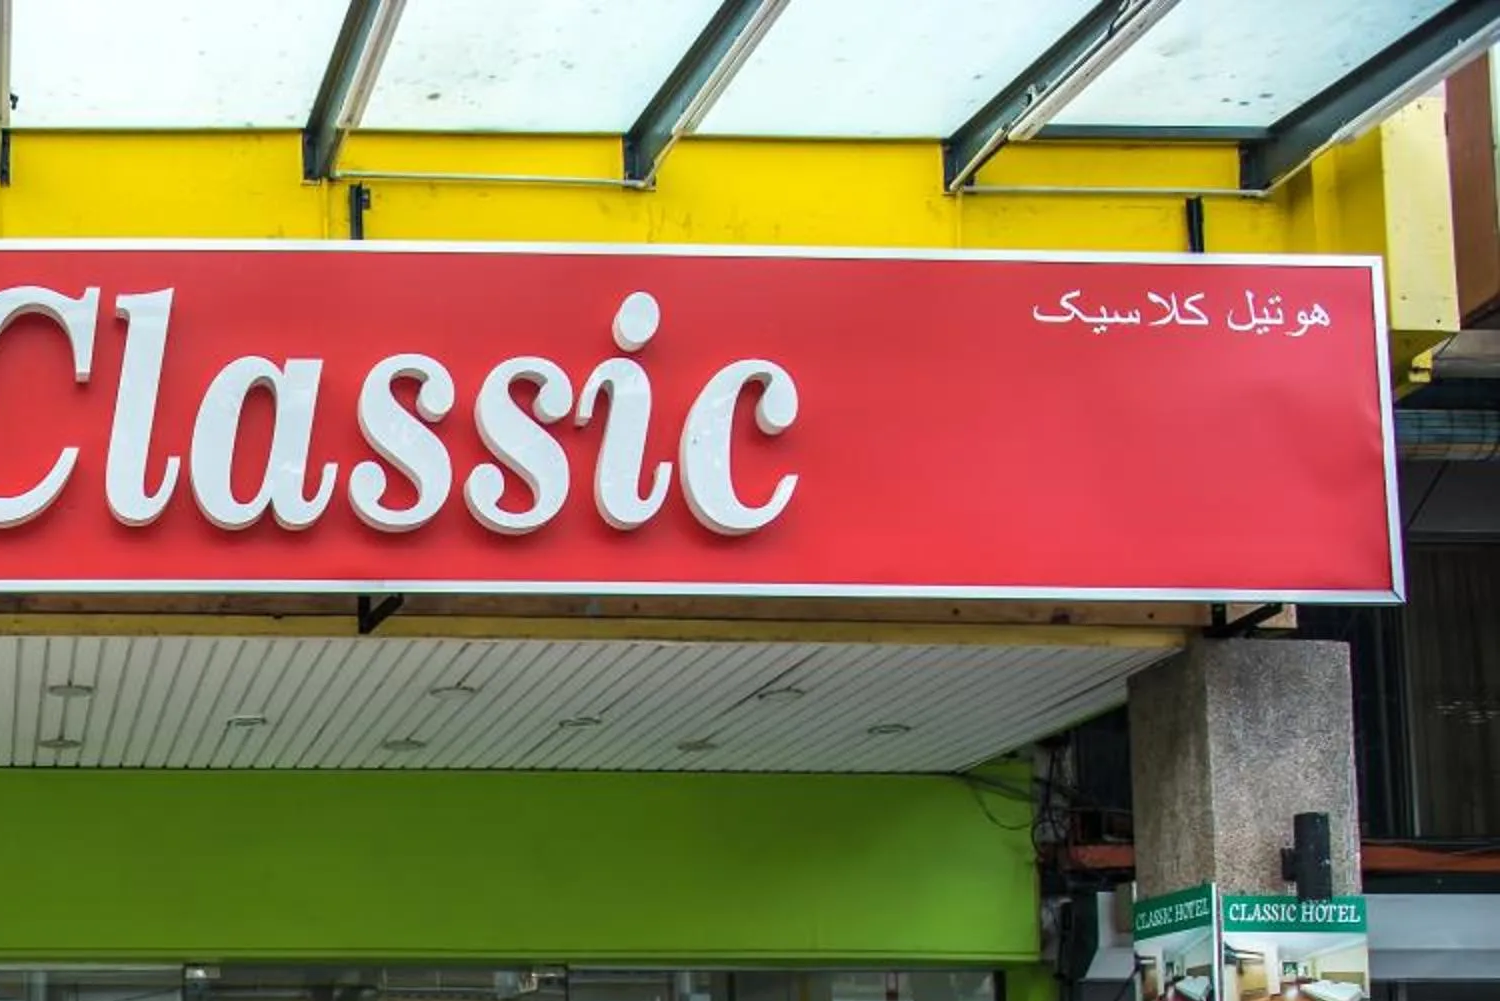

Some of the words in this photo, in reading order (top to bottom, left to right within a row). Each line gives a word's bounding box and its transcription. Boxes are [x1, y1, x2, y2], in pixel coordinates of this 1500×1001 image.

[1136, 907, 1172, 931] CLASSIC
[1174, 898, 1209, 922] HOTEL
[1229, 903, 1296, 921] CLASSIC
[1300, 902, 1361, 923] HOTEL
